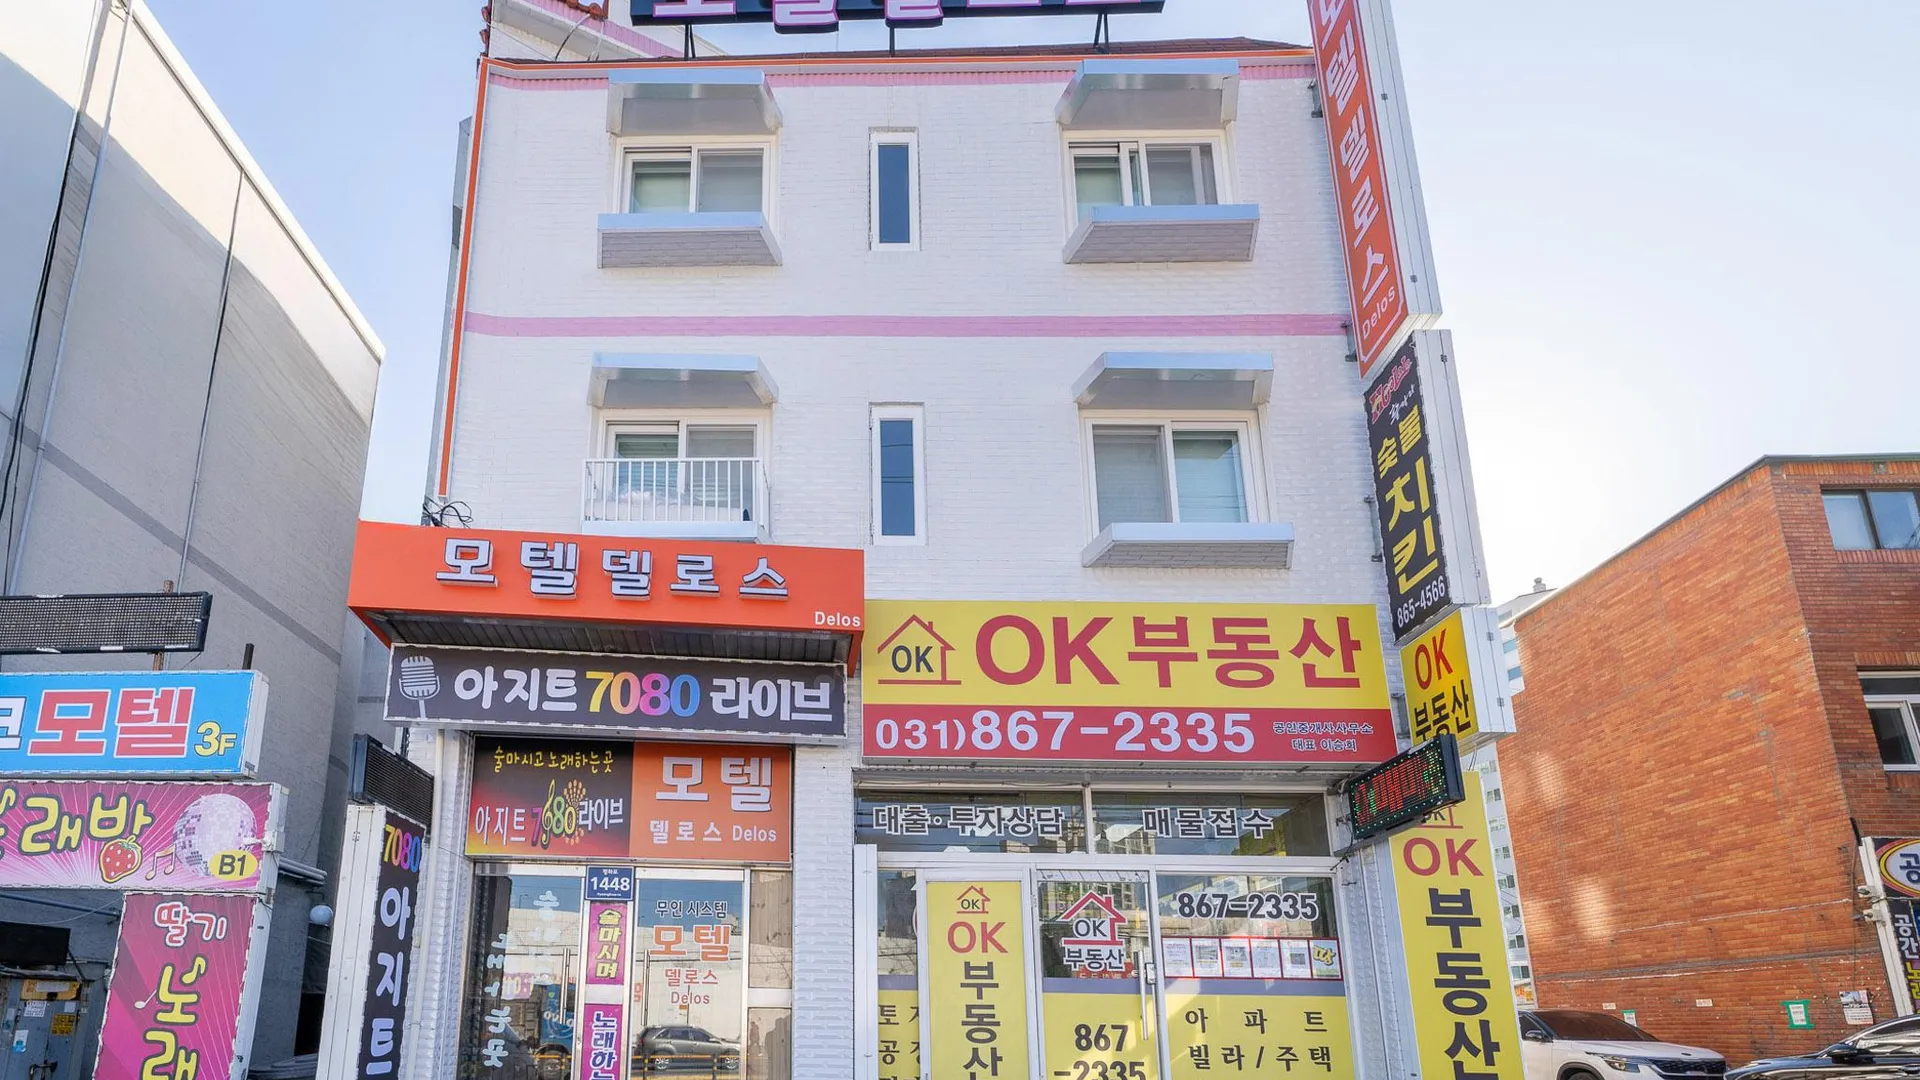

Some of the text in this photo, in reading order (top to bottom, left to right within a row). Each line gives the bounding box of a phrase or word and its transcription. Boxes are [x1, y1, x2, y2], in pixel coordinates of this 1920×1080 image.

[1362, 287, 1395, 340] Delos
[1385, 456, 1438, 596] 치킨
[1397, 575, 1445, 628] 865-4566
[814, 610, 862, 628] Delos
[890, 645, 934, 674] OK
[1415, 629, 1454, 690] OK
[709, 676, 834, 722] 라이브
[194, 720, 237, 757] 3F
[1291, 739, 1316, 751] 대표
[578, 797, 624, 831] 라이브
[732, 824, 777, 843] Delos
[384, 824, 421, 873] 7080
[1403, 837, 1485, 877] OK
[217, 855, 249, 878] B1
[590, 876, 630, 891] 1448
[656, 900, 728, 919] 무인 시스템
[960, 898, 981, 910] OK
[1177, 892, 1319, 921] 867-2335
[155, 902, 227, 947] 딸기
[947, 921, 1009, 954] OK
[1074, 919, 1107, 937] OK
[649, 924, 732, 962] 모텔
[1064, 948, 1124, 970] 부동산
[665, 968, 719, 988] 델로스
[671, 991, 710, 1005] Delos
[1074, 1023, 1129, 1052] 867
